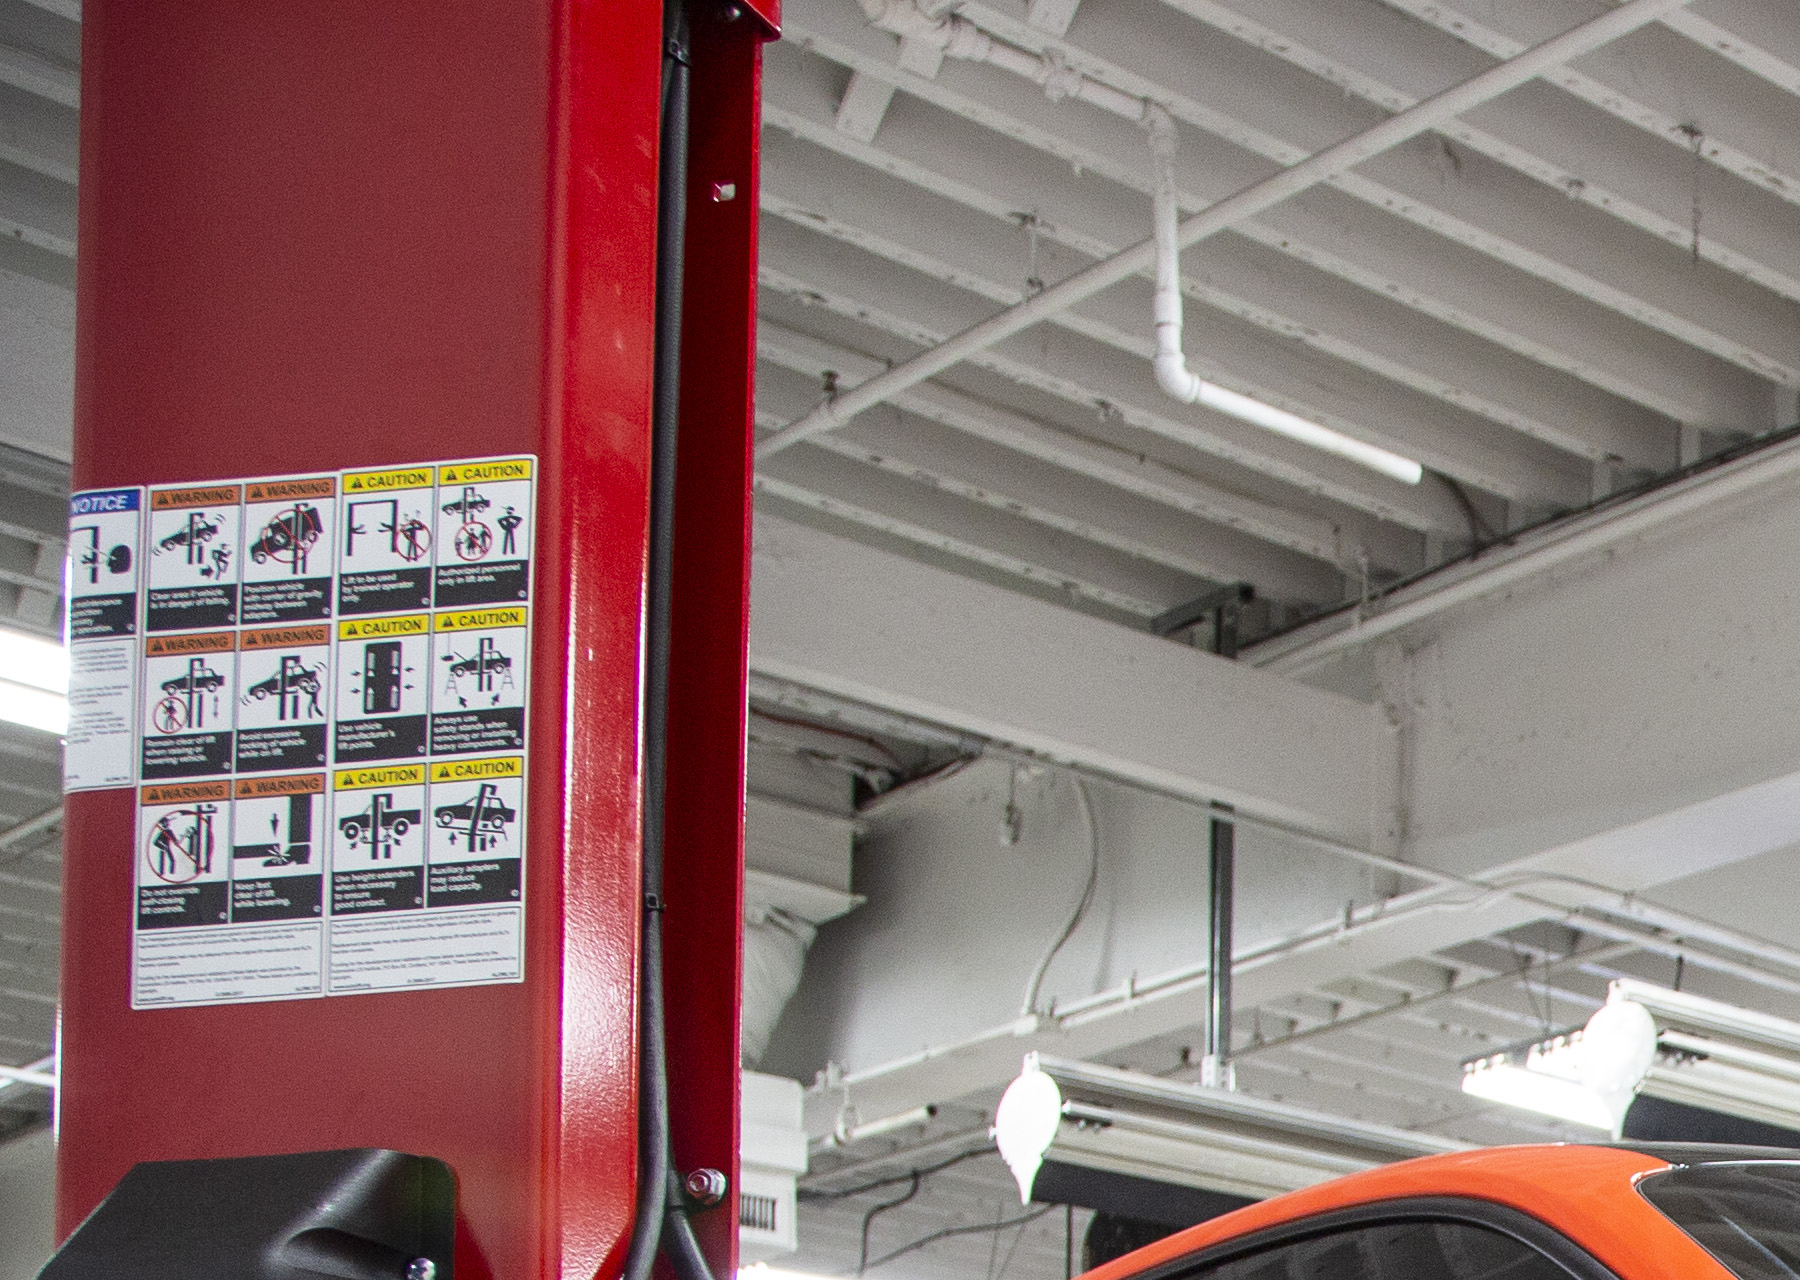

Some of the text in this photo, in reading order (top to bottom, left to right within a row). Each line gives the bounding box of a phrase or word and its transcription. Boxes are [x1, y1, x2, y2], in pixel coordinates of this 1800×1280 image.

[464, 464, 523, 480] CAUTION
[265, 480, 331, 497] WARNING
[367, 472, 427, 489] CAUTION
[168, 489, 234, 505] WARNING
[362, 618, 422, 635] CAUTION
[459, 611, 519, 628] CAUTION
[164, 635, 228, 651] WARNING
[259, 629, 325, 644] WARNING
[358, 768, 418, 785] CAUTION
[455, 761, 515, 777] CAUTION
[161, 785, 224, 800] WARNING
[256, 778, 320, 793] WARNING
